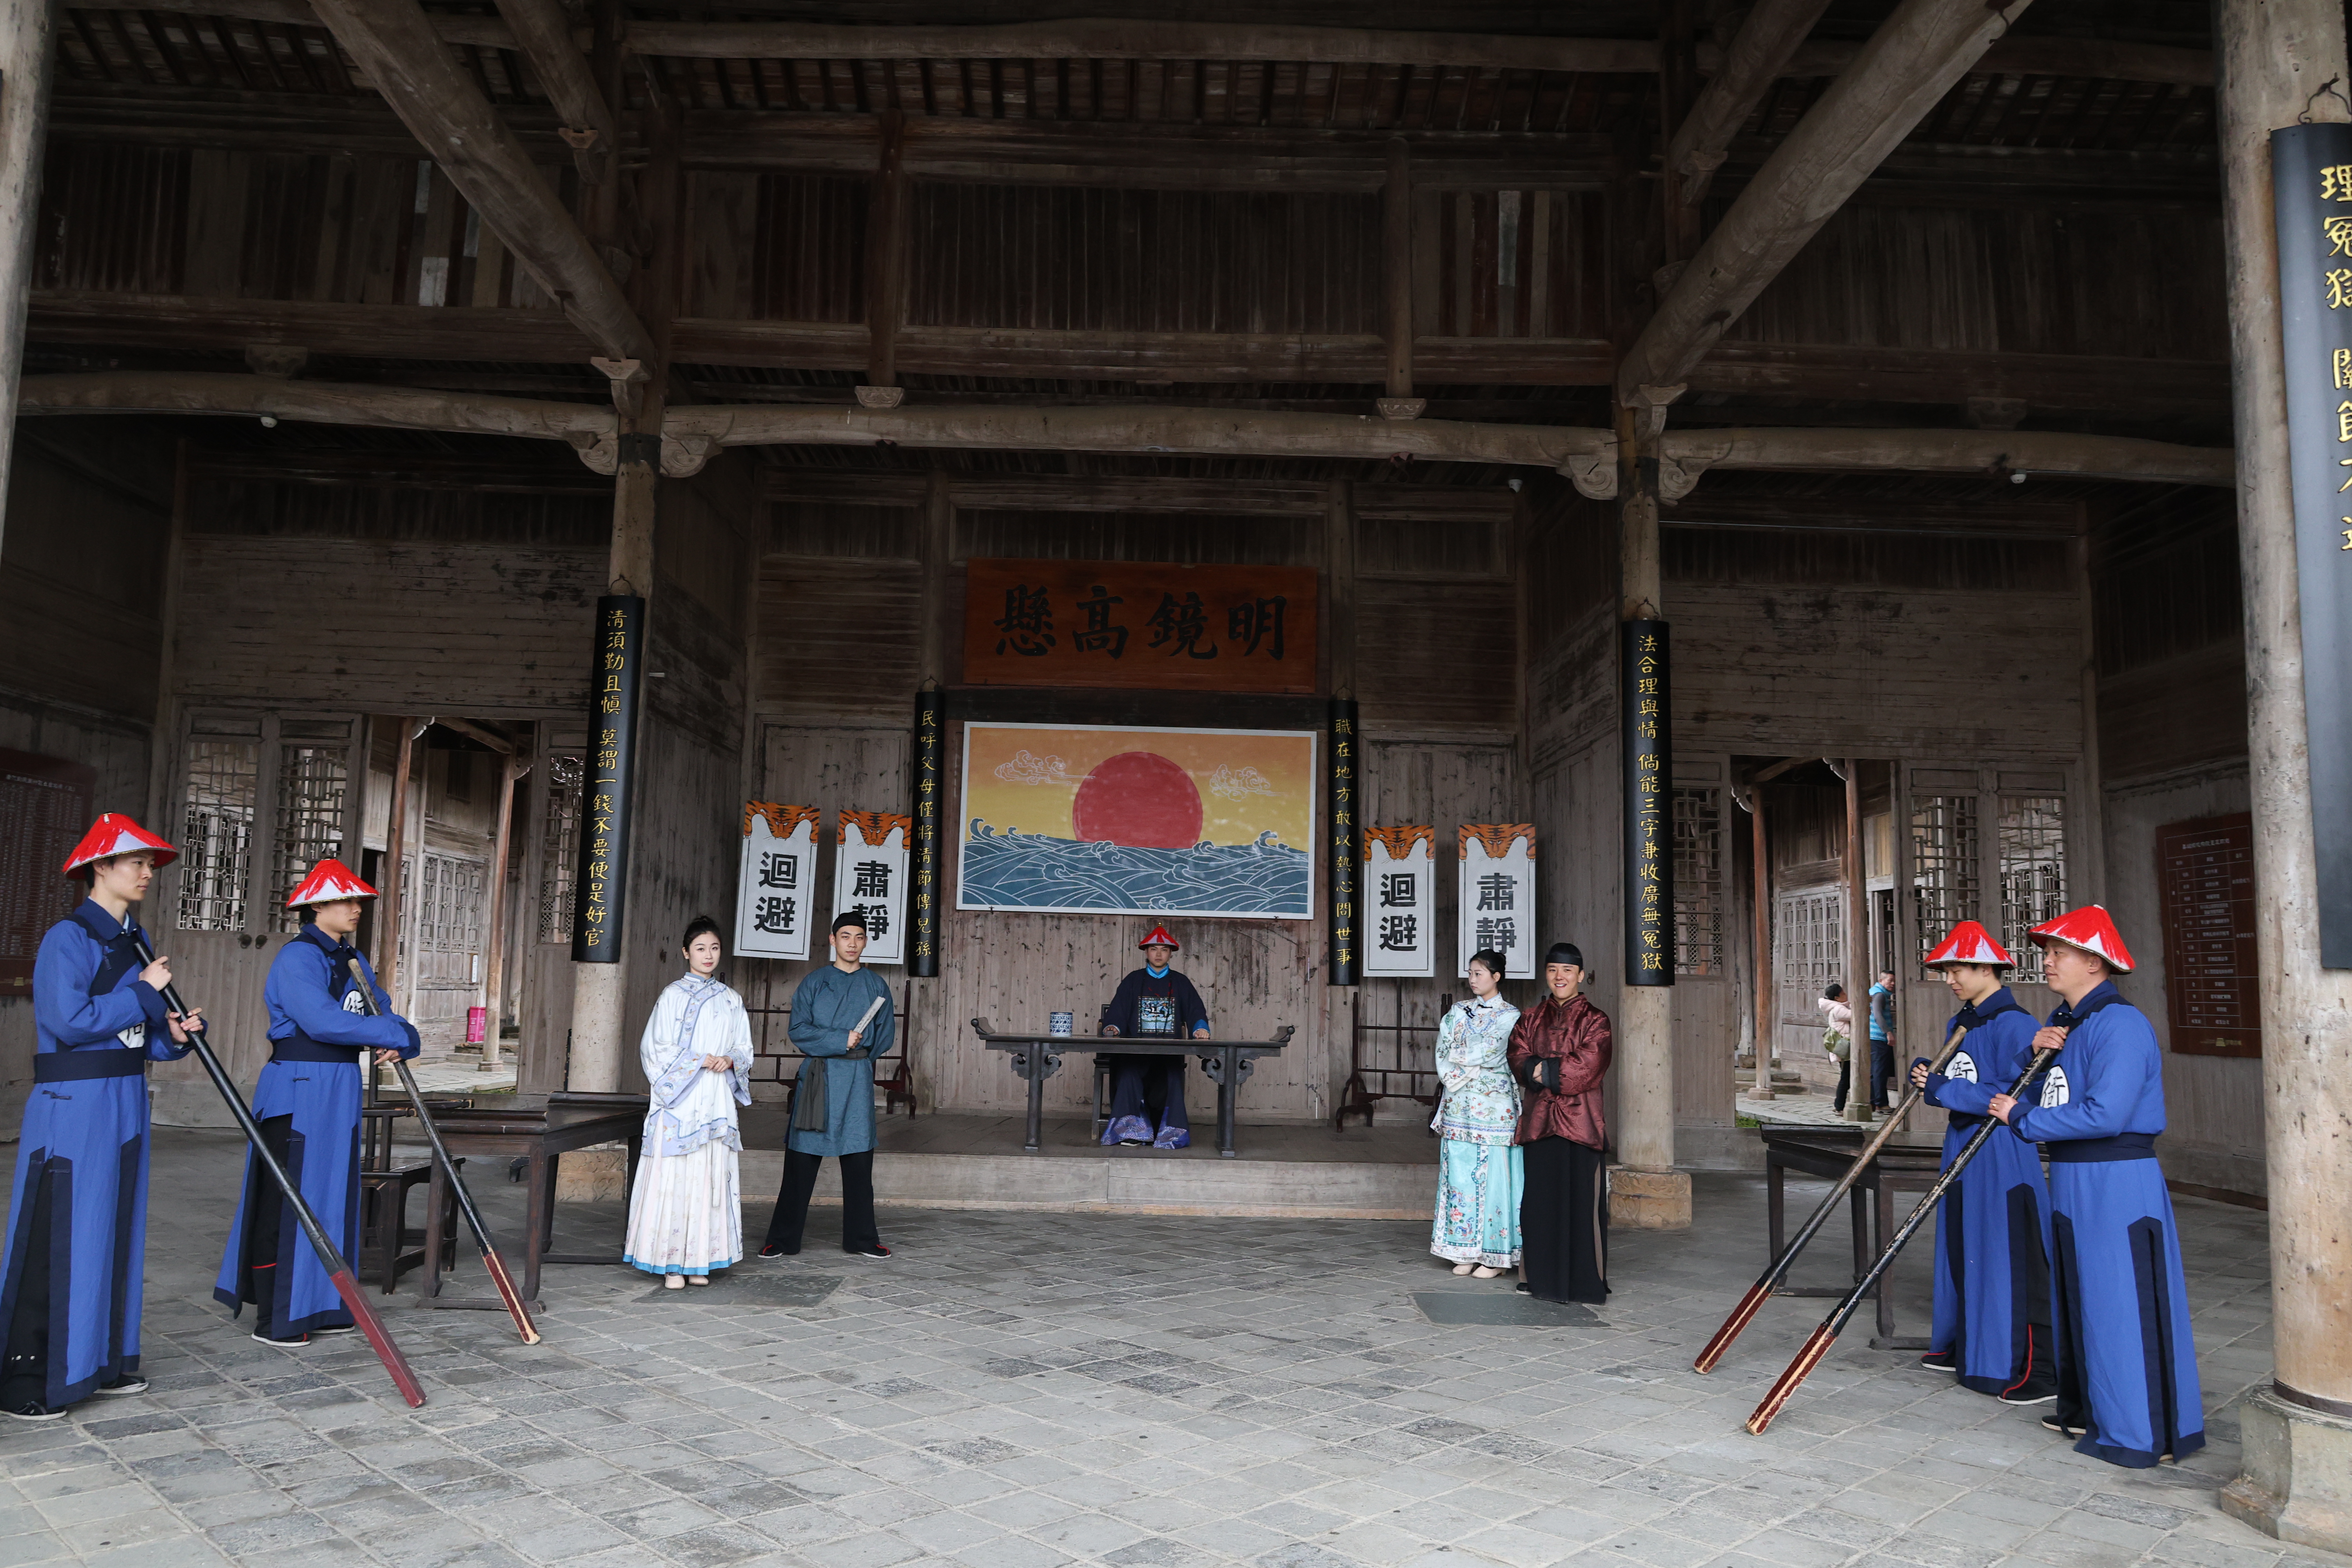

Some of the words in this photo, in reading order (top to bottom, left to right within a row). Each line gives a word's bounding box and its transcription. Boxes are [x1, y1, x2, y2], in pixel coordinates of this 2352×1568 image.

[993, 584, 1287, 661] 明鏡高懸
[753, 851, 798, 935] 迴避
[1379, 873, 1418, 951] 迴避
